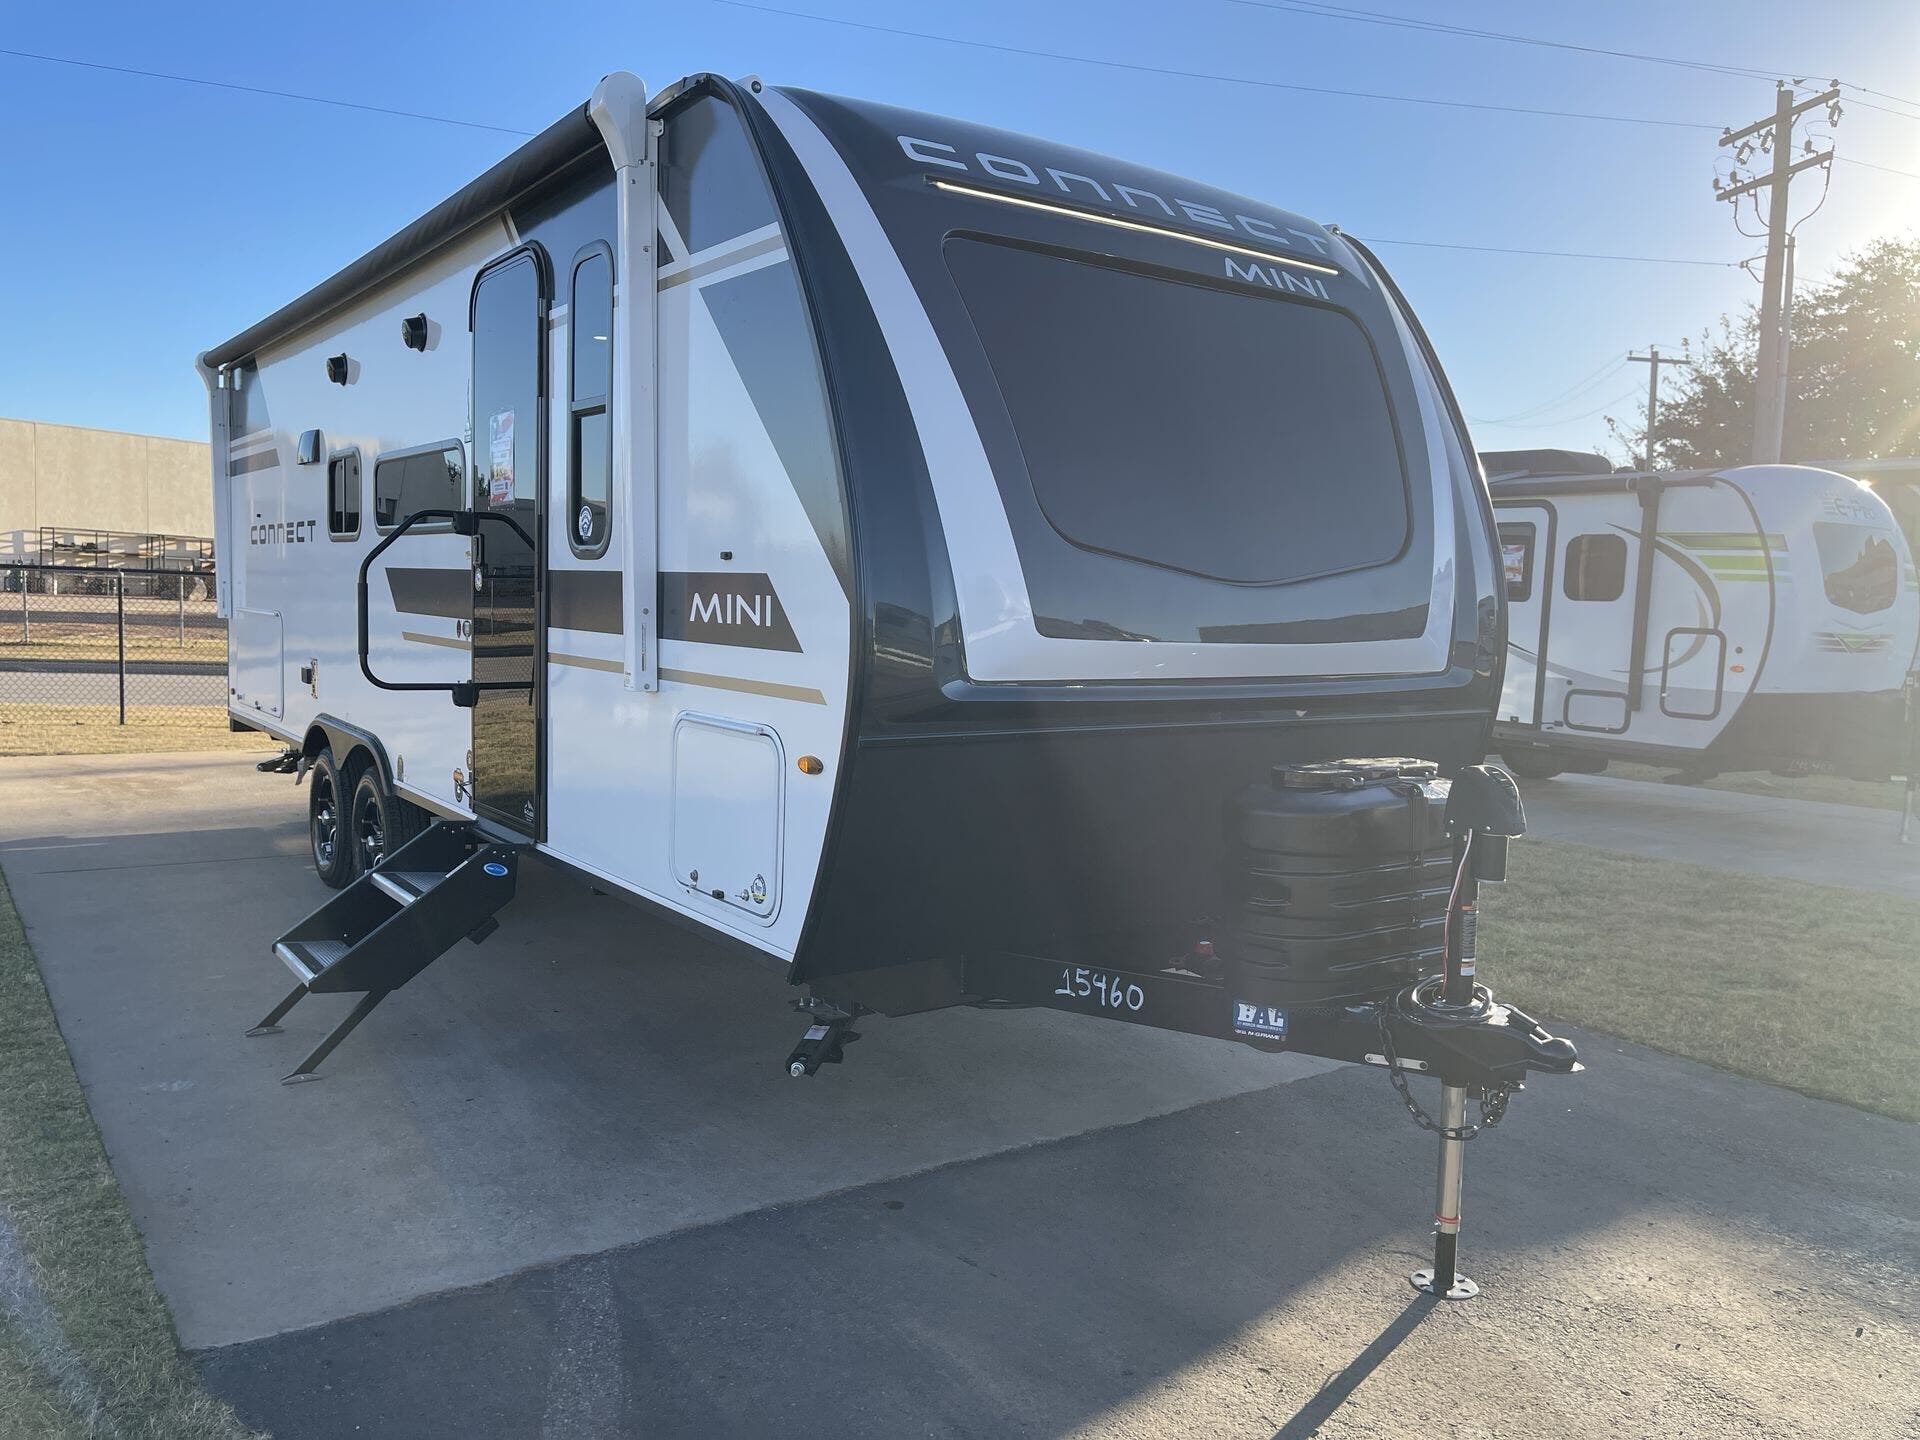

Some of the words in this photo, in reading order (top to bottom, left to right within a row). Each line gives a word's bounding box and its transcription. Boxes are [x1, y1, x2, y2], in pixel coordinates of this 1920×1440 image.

[897, 135, 1329, 254] CONNECT
[1224, 256, 1330, 300] MINI
[250, 520, 316, 545] CONNECT
[689, 592, 772, 627] MINI
[1054, 967, 1144, 1011] 15460
[1237, 1003, 1285, 1028] BAL
